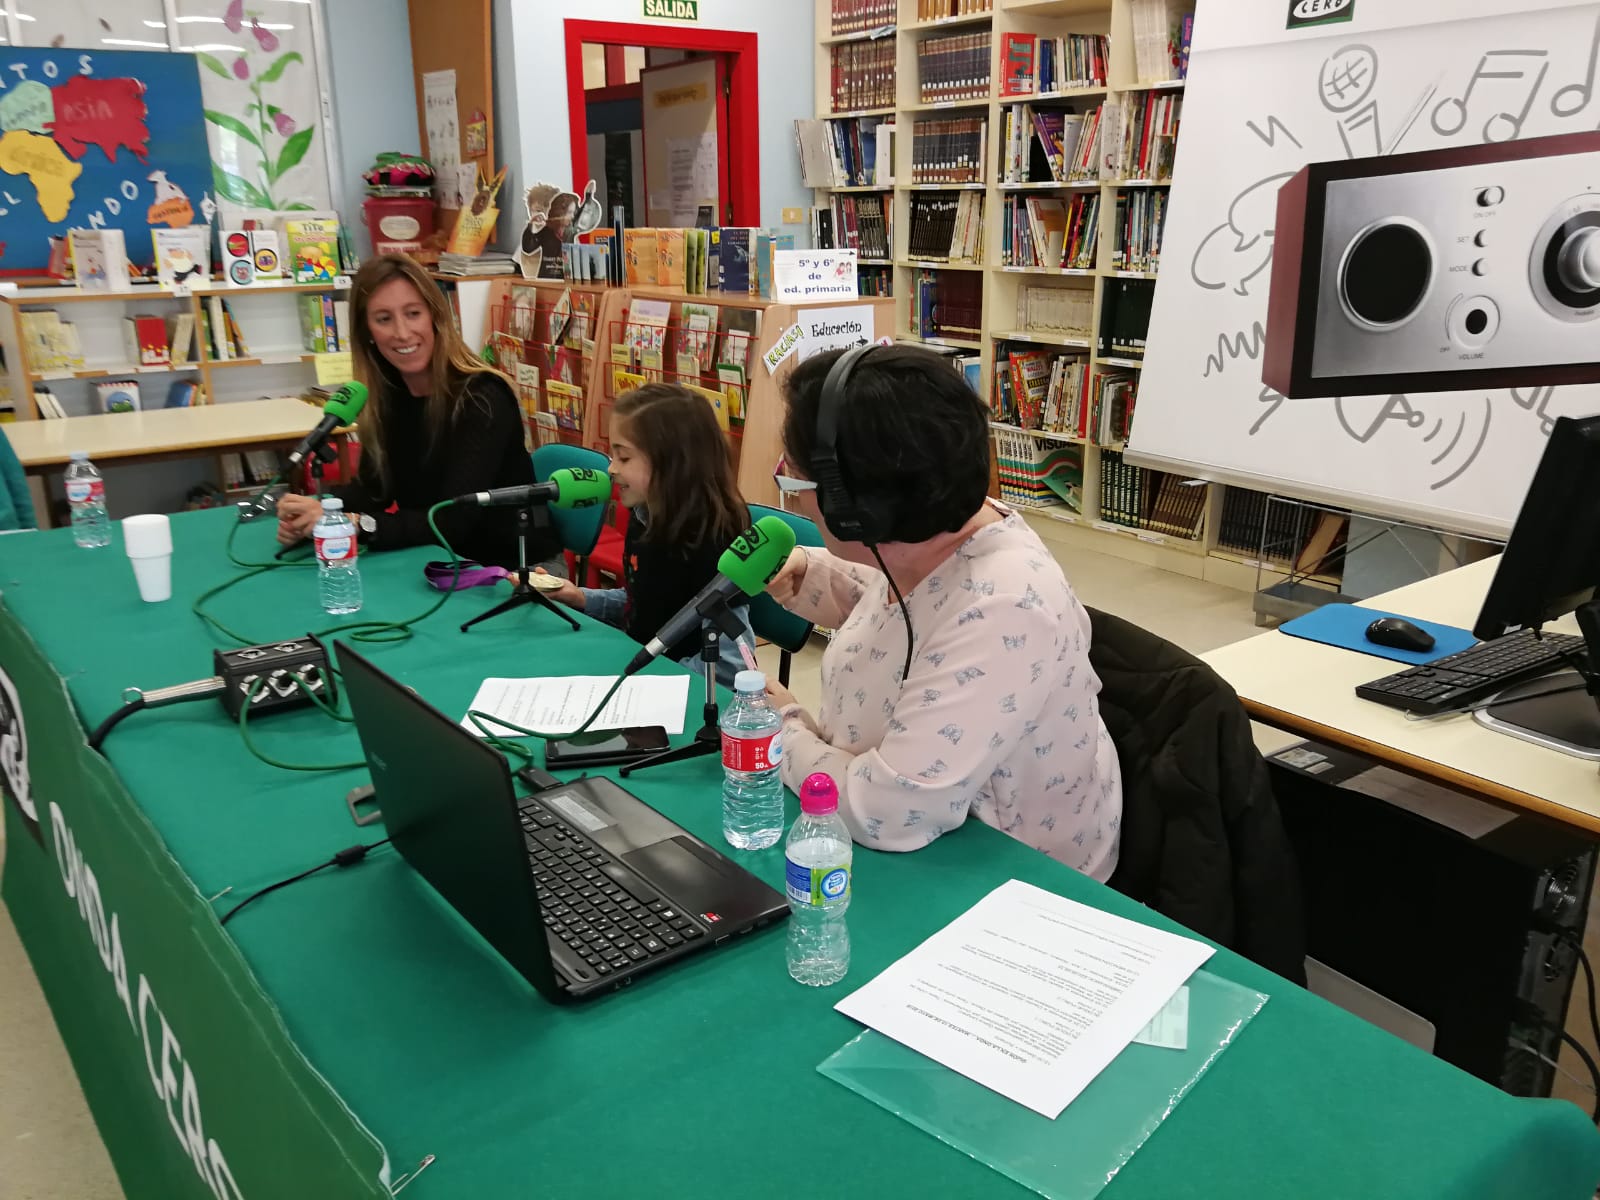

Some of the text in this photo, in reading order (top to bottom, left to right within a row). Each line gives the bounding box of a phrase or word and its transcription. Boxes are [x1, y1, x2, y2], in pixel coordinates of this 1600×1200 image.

[646, 0, 695, 18] SALIDA
[813, 260, 820, 268] y
[808, 271, 822, 280] de
[783, 284, 852, 295] ed. primaria
[811, 320, 863, 338] Educación
[1458, 352, 1485, 361] VOLUME
[50, 801, 137, 1036] ONDA
